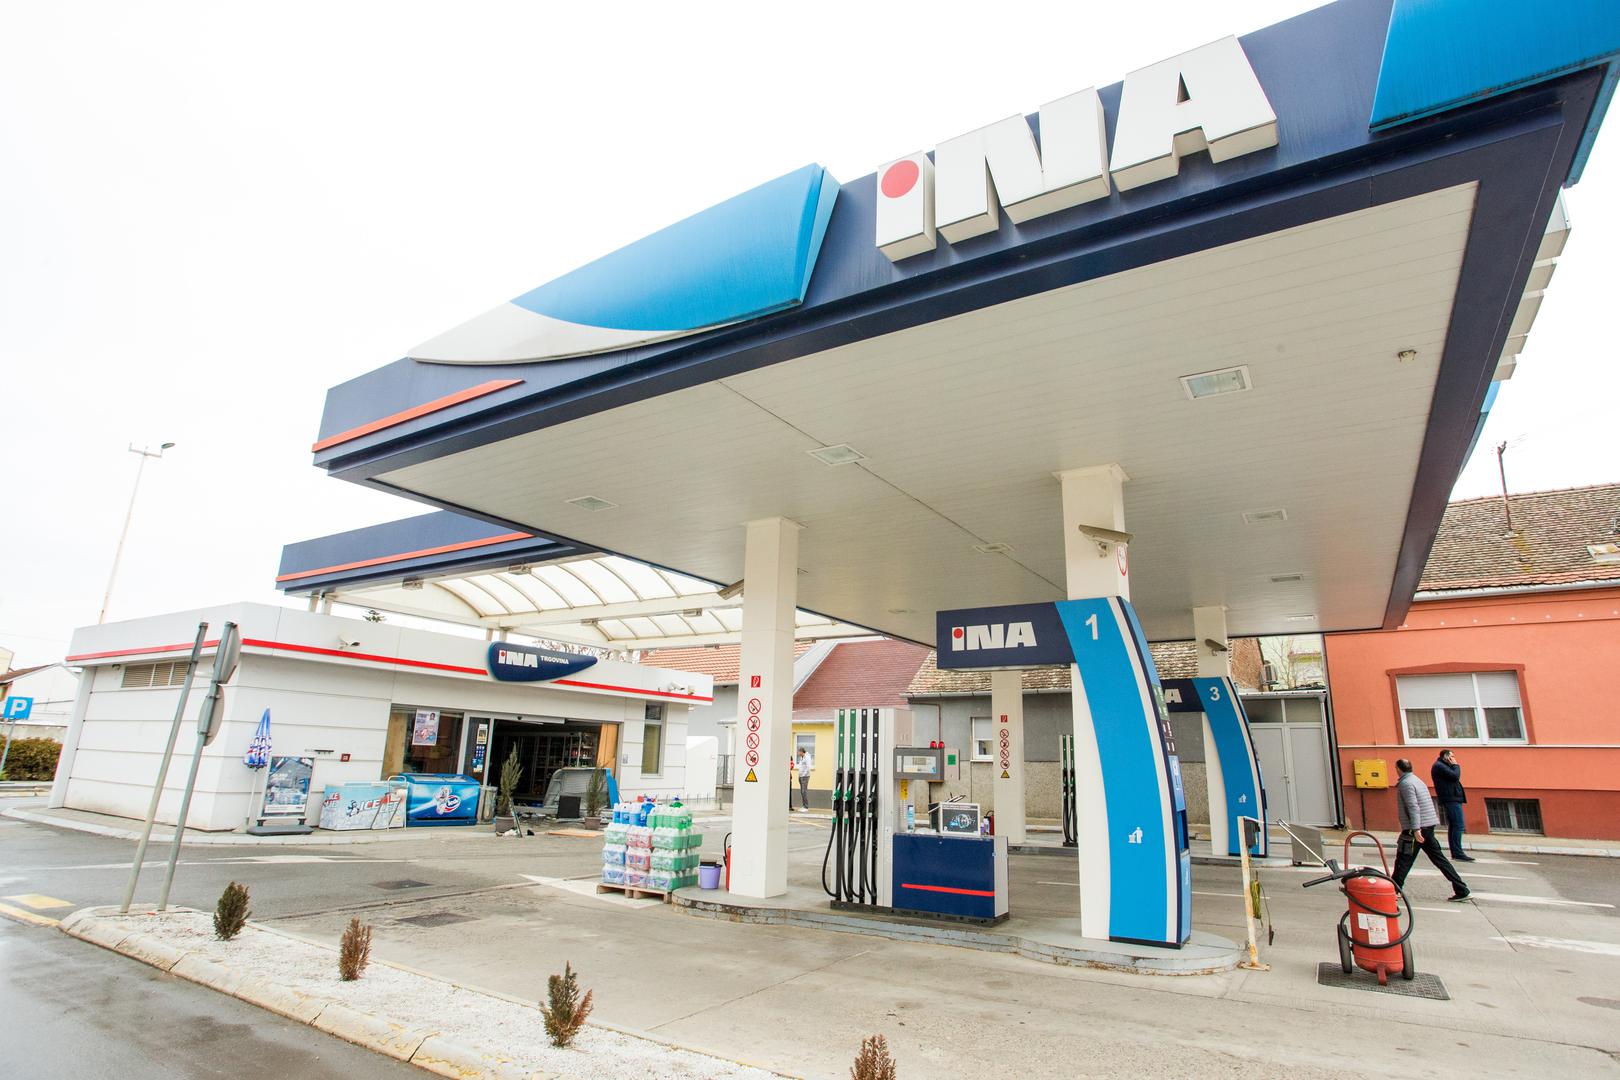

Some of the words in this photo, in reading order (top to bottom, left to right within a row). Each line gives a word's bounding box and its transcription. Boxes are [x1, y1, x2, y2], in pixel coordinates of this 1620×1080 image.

[876, 34, 1278, 260] INA
[951, 621, 1037, 652] INA
[1084, 613, 1099, 641] 1
[498, 650, 538, 668] INA
[540, 655, 570, 665] TRGOVINA
[1209, 687, 1221, 702] 3
[10, 699, 27, 716] P
